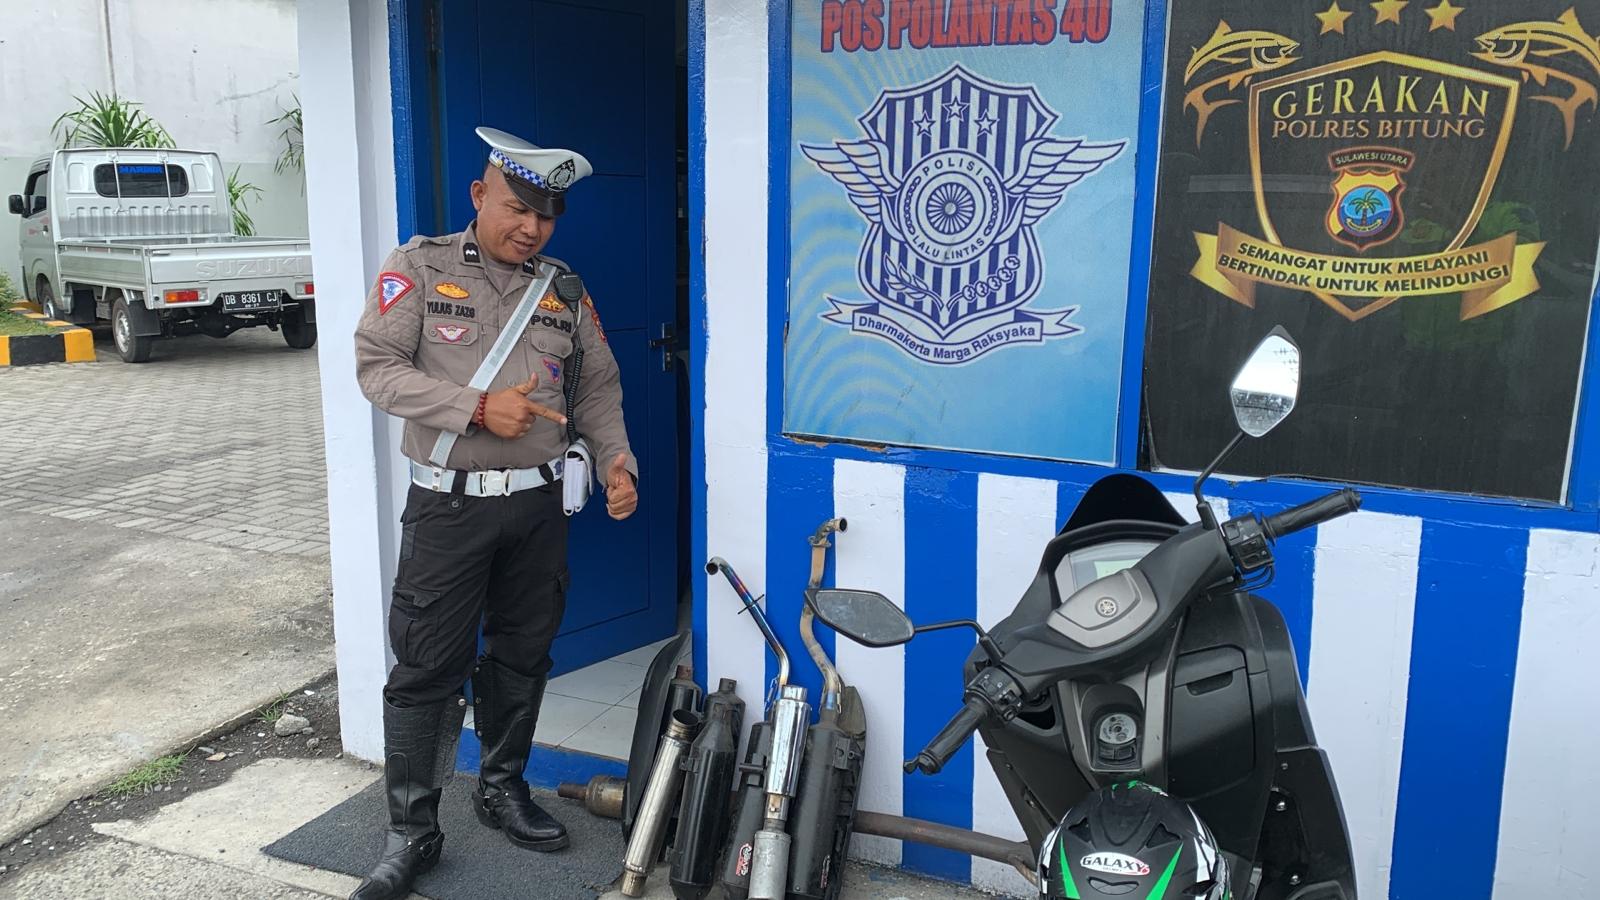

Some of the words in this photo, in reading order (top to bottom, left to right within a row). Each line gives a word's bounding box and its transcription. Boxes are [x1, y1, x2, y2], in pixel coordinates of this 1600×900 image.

[821, 0, 884, 52] POS
[888, 0, 1057, 49] POLANTAS
[1272, 75, 1489, 119] GERAKAN
[1271, 119, 1370, 139] POLRES
[1376, 119, 1485, 139] BITUNG
[922, 157, 983, 177] POLISI
[1335, 152, 1378, 165] SULAWESI
[1380, 153, 1408, 165] UTARA
[912, 235, 940, 258] LALU
[944, 237, 985, 260] LINTAS
[196, 257, 302, 278] SUZUKI
[1237, 242, 1327, 271] SEMANGAT
[1331, 261, 1392, 275] UNTUK
[1397, 251, 1489, 274] MELAYANI
[1218, 254, 1312, 287] BERTINDAK
[1316, 277, 1378, 292] UNTUK
[1384, 265, 1509, 292] MELINDUNGI
[225, 294, 236, 305] DB
[241, 293, 261, 304] 8361
[266, 291, 277, 302] CJ
[530, 315, 572, 333] POLRI
[858, 315, 930, 358] Dharmakerta
[933, 347, 970, 360] Marga
[973, 325, 1036, 353] Raksyaka
[1082, 856, 1144, 873] GALAXY
